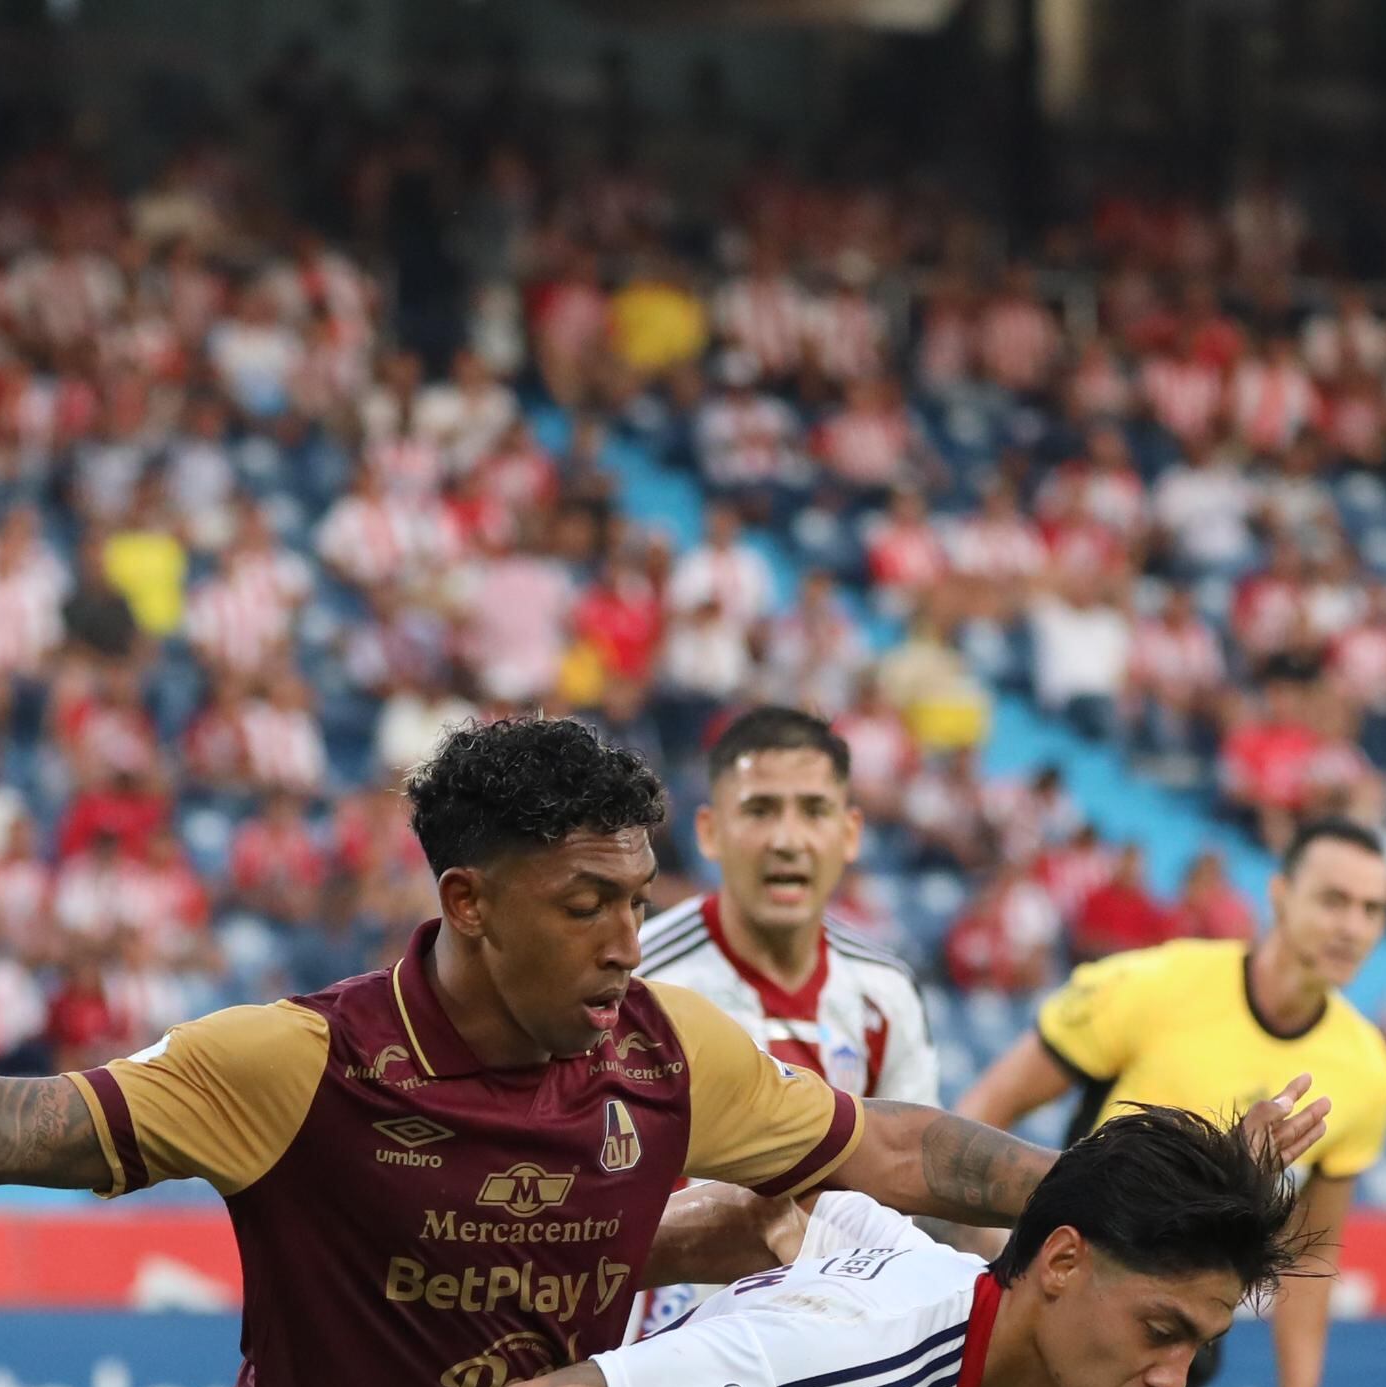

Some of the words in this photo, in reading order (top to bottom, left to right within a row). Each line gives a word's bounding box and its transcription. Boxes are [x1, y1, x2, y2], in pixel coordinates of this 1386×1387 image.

[375, 1148, 443, 1169] umbro
[419, 1209, 618, 1244] Mercacentro
[386, 1256, 590, 1323] BetPlay
